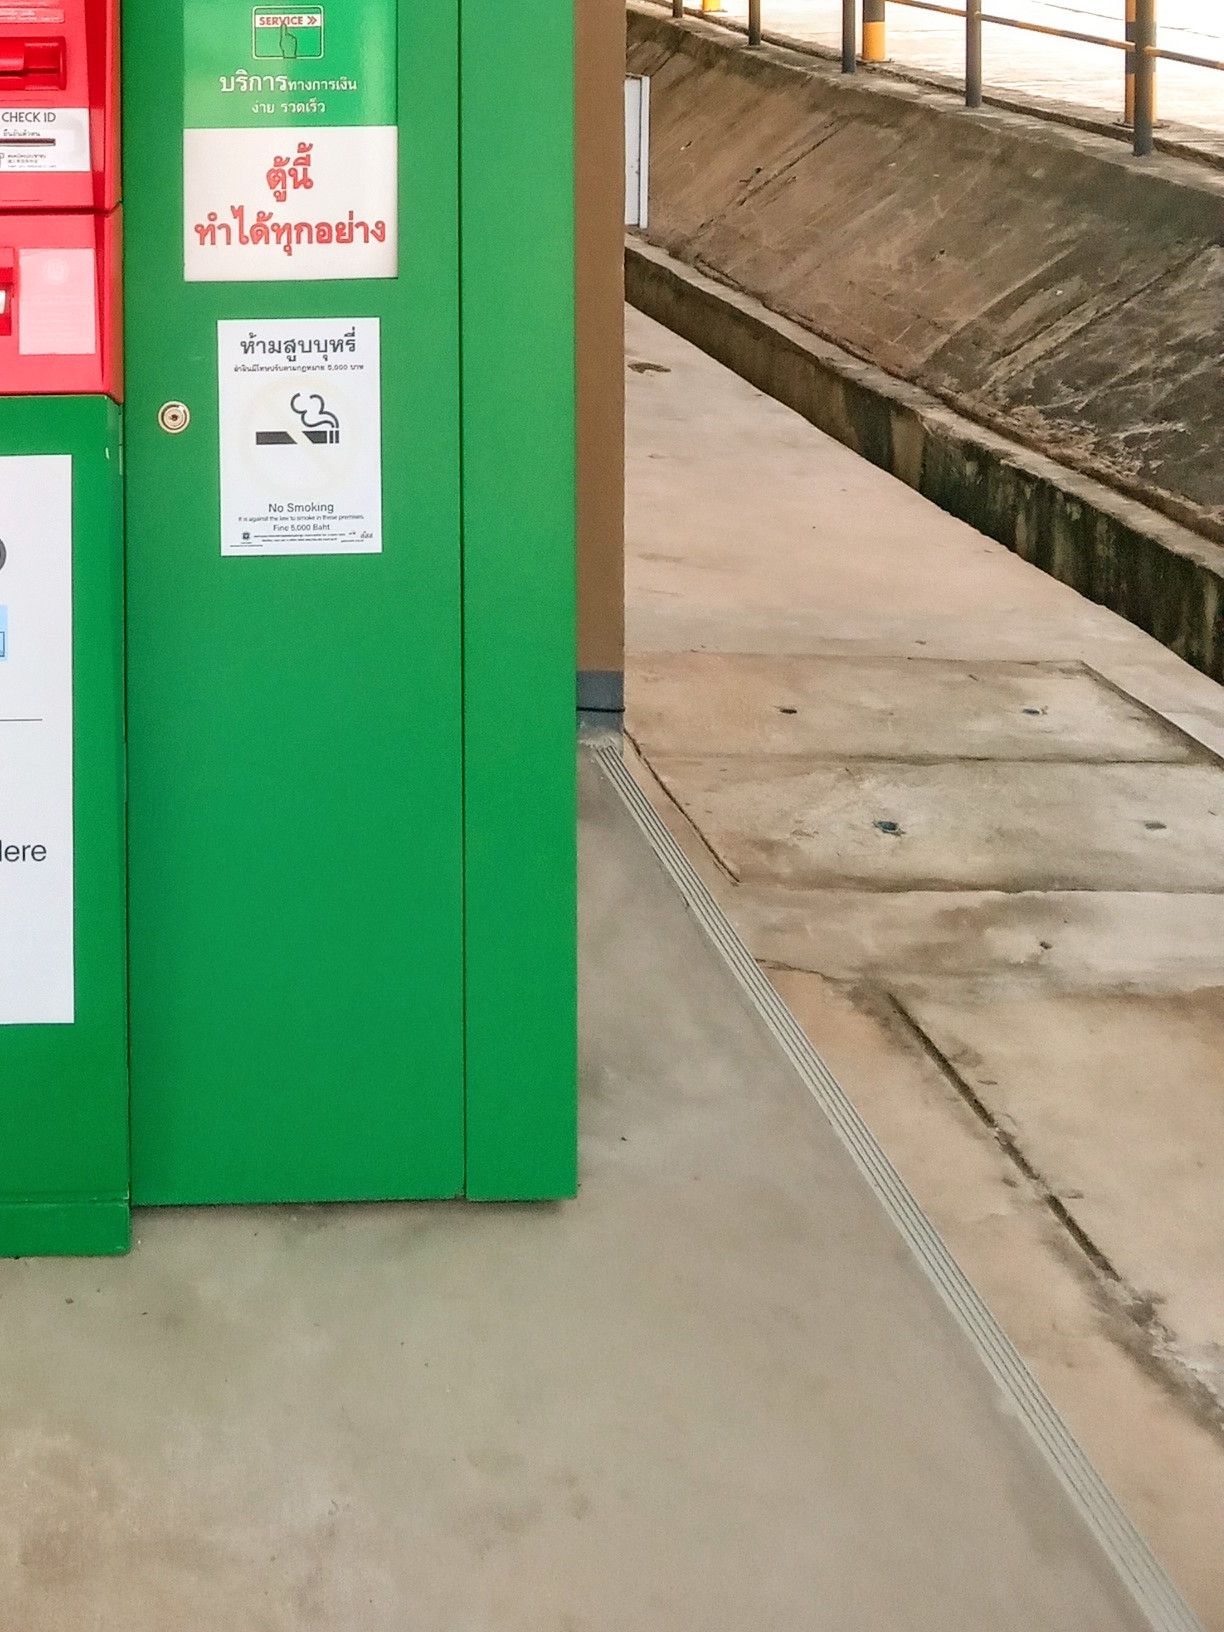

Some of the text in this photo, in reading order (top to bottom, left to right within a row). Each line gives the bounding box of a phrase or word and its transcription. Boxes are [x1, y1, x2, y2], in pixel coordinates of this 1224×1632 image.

[259, 16, 304, 26] SERVICE
[251, 97, 326, 114] ง่าย รวดเร็ว
[1, 111, 42, 123] CHECK
[43, 111, 57, 123] ID
[266, 141, 314, 202] ตู้นี้
[194, 205, 387, 257] ทำได้ทุกอย่าง
[240, 326, 356, 362] ห้ามสูบบุหรี่
[268, 502, 334, 514] No Smoking
[273, 524, 289, 532] Fine
[312, 523, 330, 531] Baht
